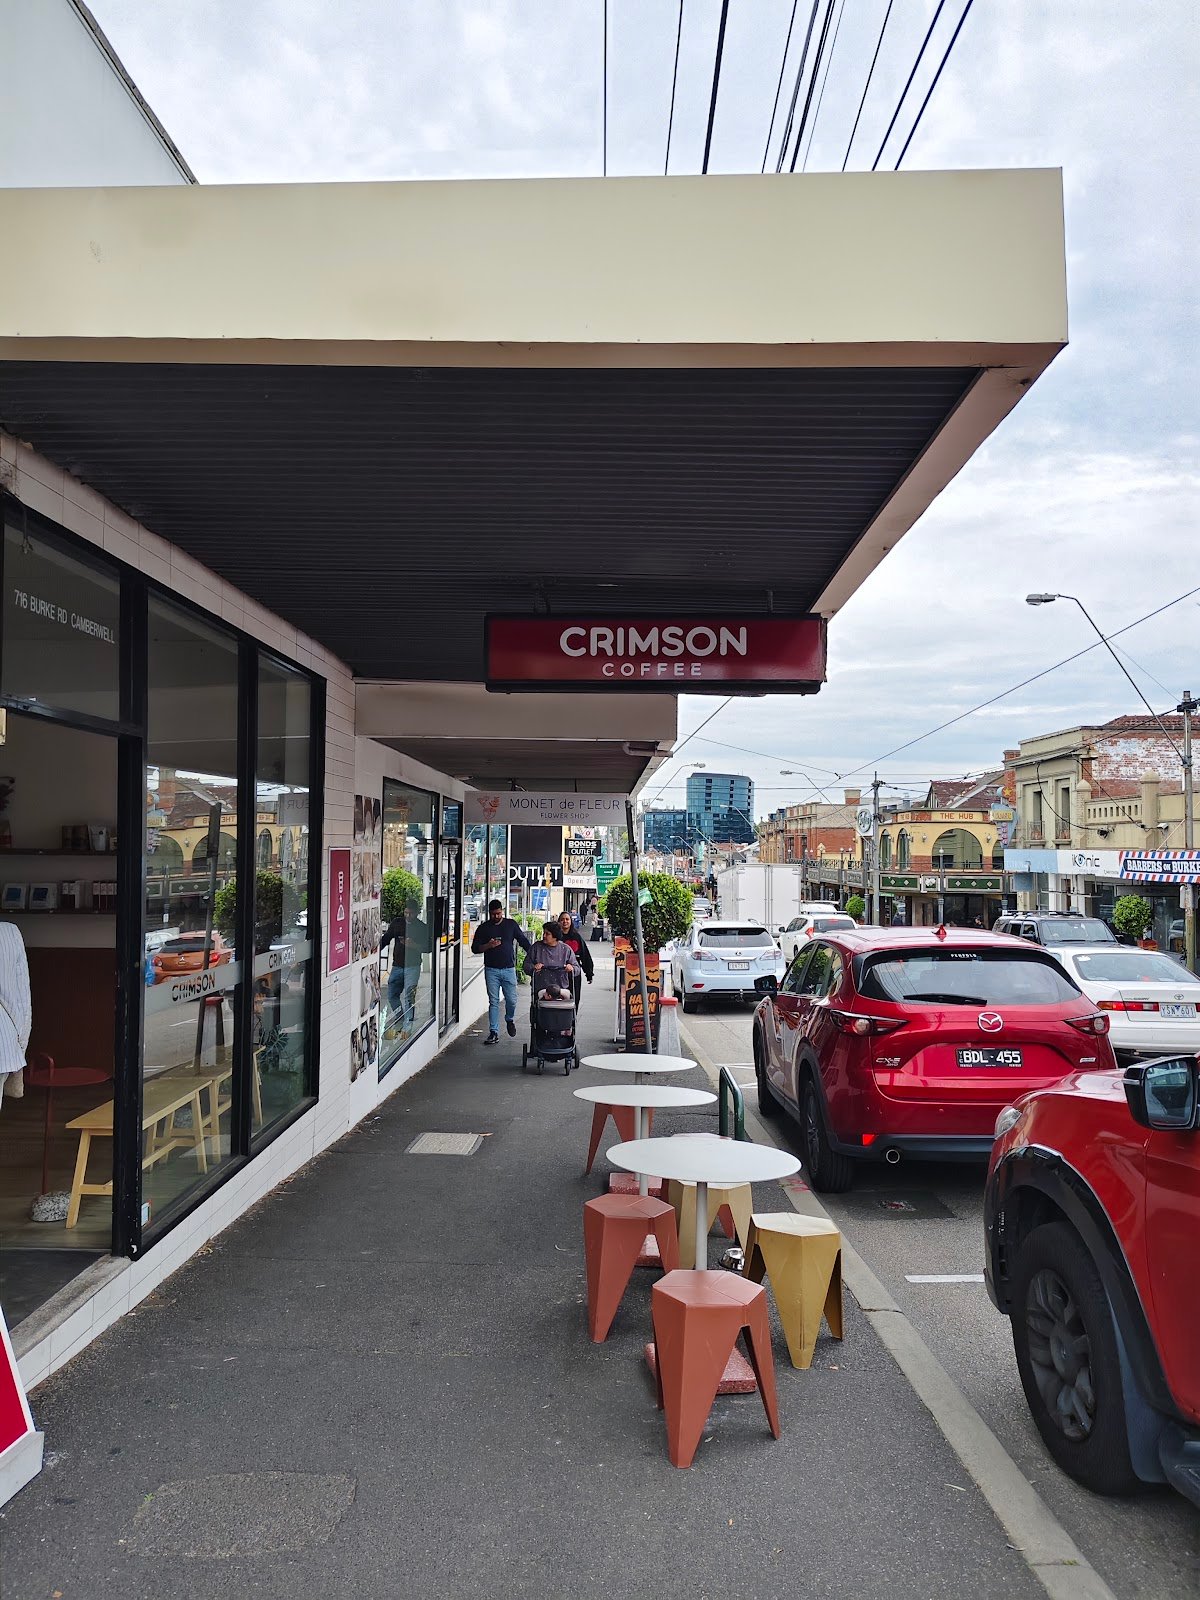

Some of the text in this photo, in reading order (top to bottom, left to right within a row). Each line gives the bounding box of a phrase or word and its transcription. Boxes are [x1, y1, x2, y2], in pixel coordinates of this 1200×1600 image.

[14, 589, 115, 643] 716 BURKE RD CAMBERWELL
[559, 626, 748, 657] CRIMSON
[601, 662, 703, 677] COFFEE
[509, 798, 620, 810] MONET de FLEUR
[509, 866, 561, 880] OUTLT
[1126, 860, 1163, 872] BARBERS
[1171, 860, 1200, 873] BURKE
[568, 877, 584, 885] Open
[171, 972, 216, 1001] CRIMSON
